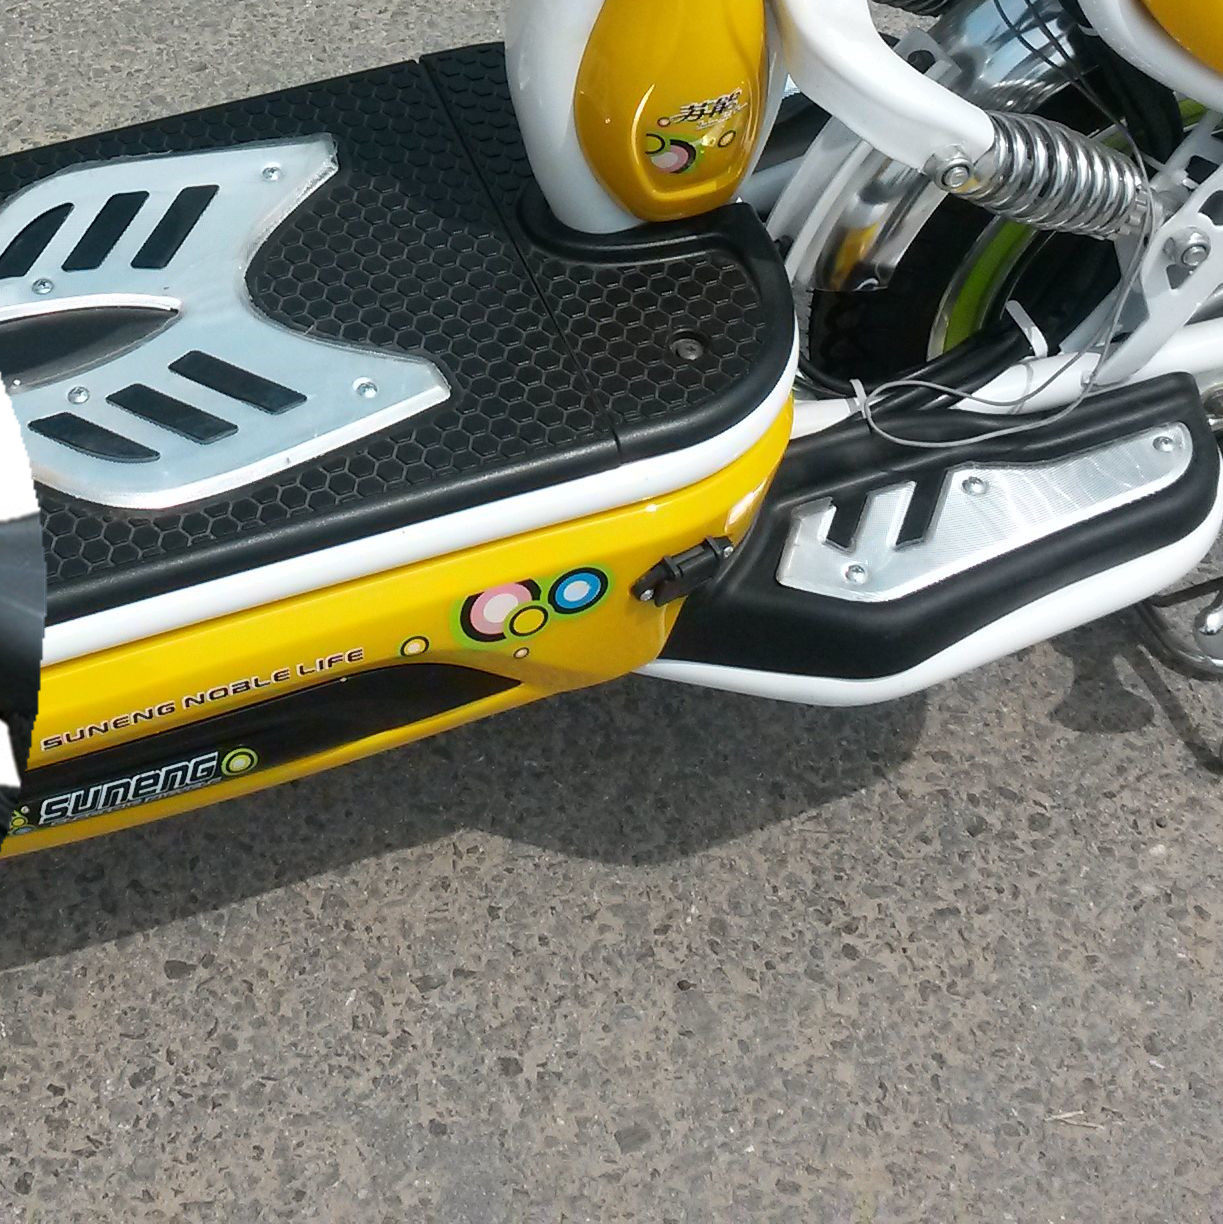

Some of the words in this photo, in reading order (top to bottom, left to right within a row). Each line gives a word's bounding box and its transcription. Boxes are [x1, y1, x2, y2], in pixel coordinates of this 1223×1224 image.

[41, 701, 176, 752] SUNENG
[183, 668, 292, 709] NOBLE
[297, 647, 364, 677] LIFE
